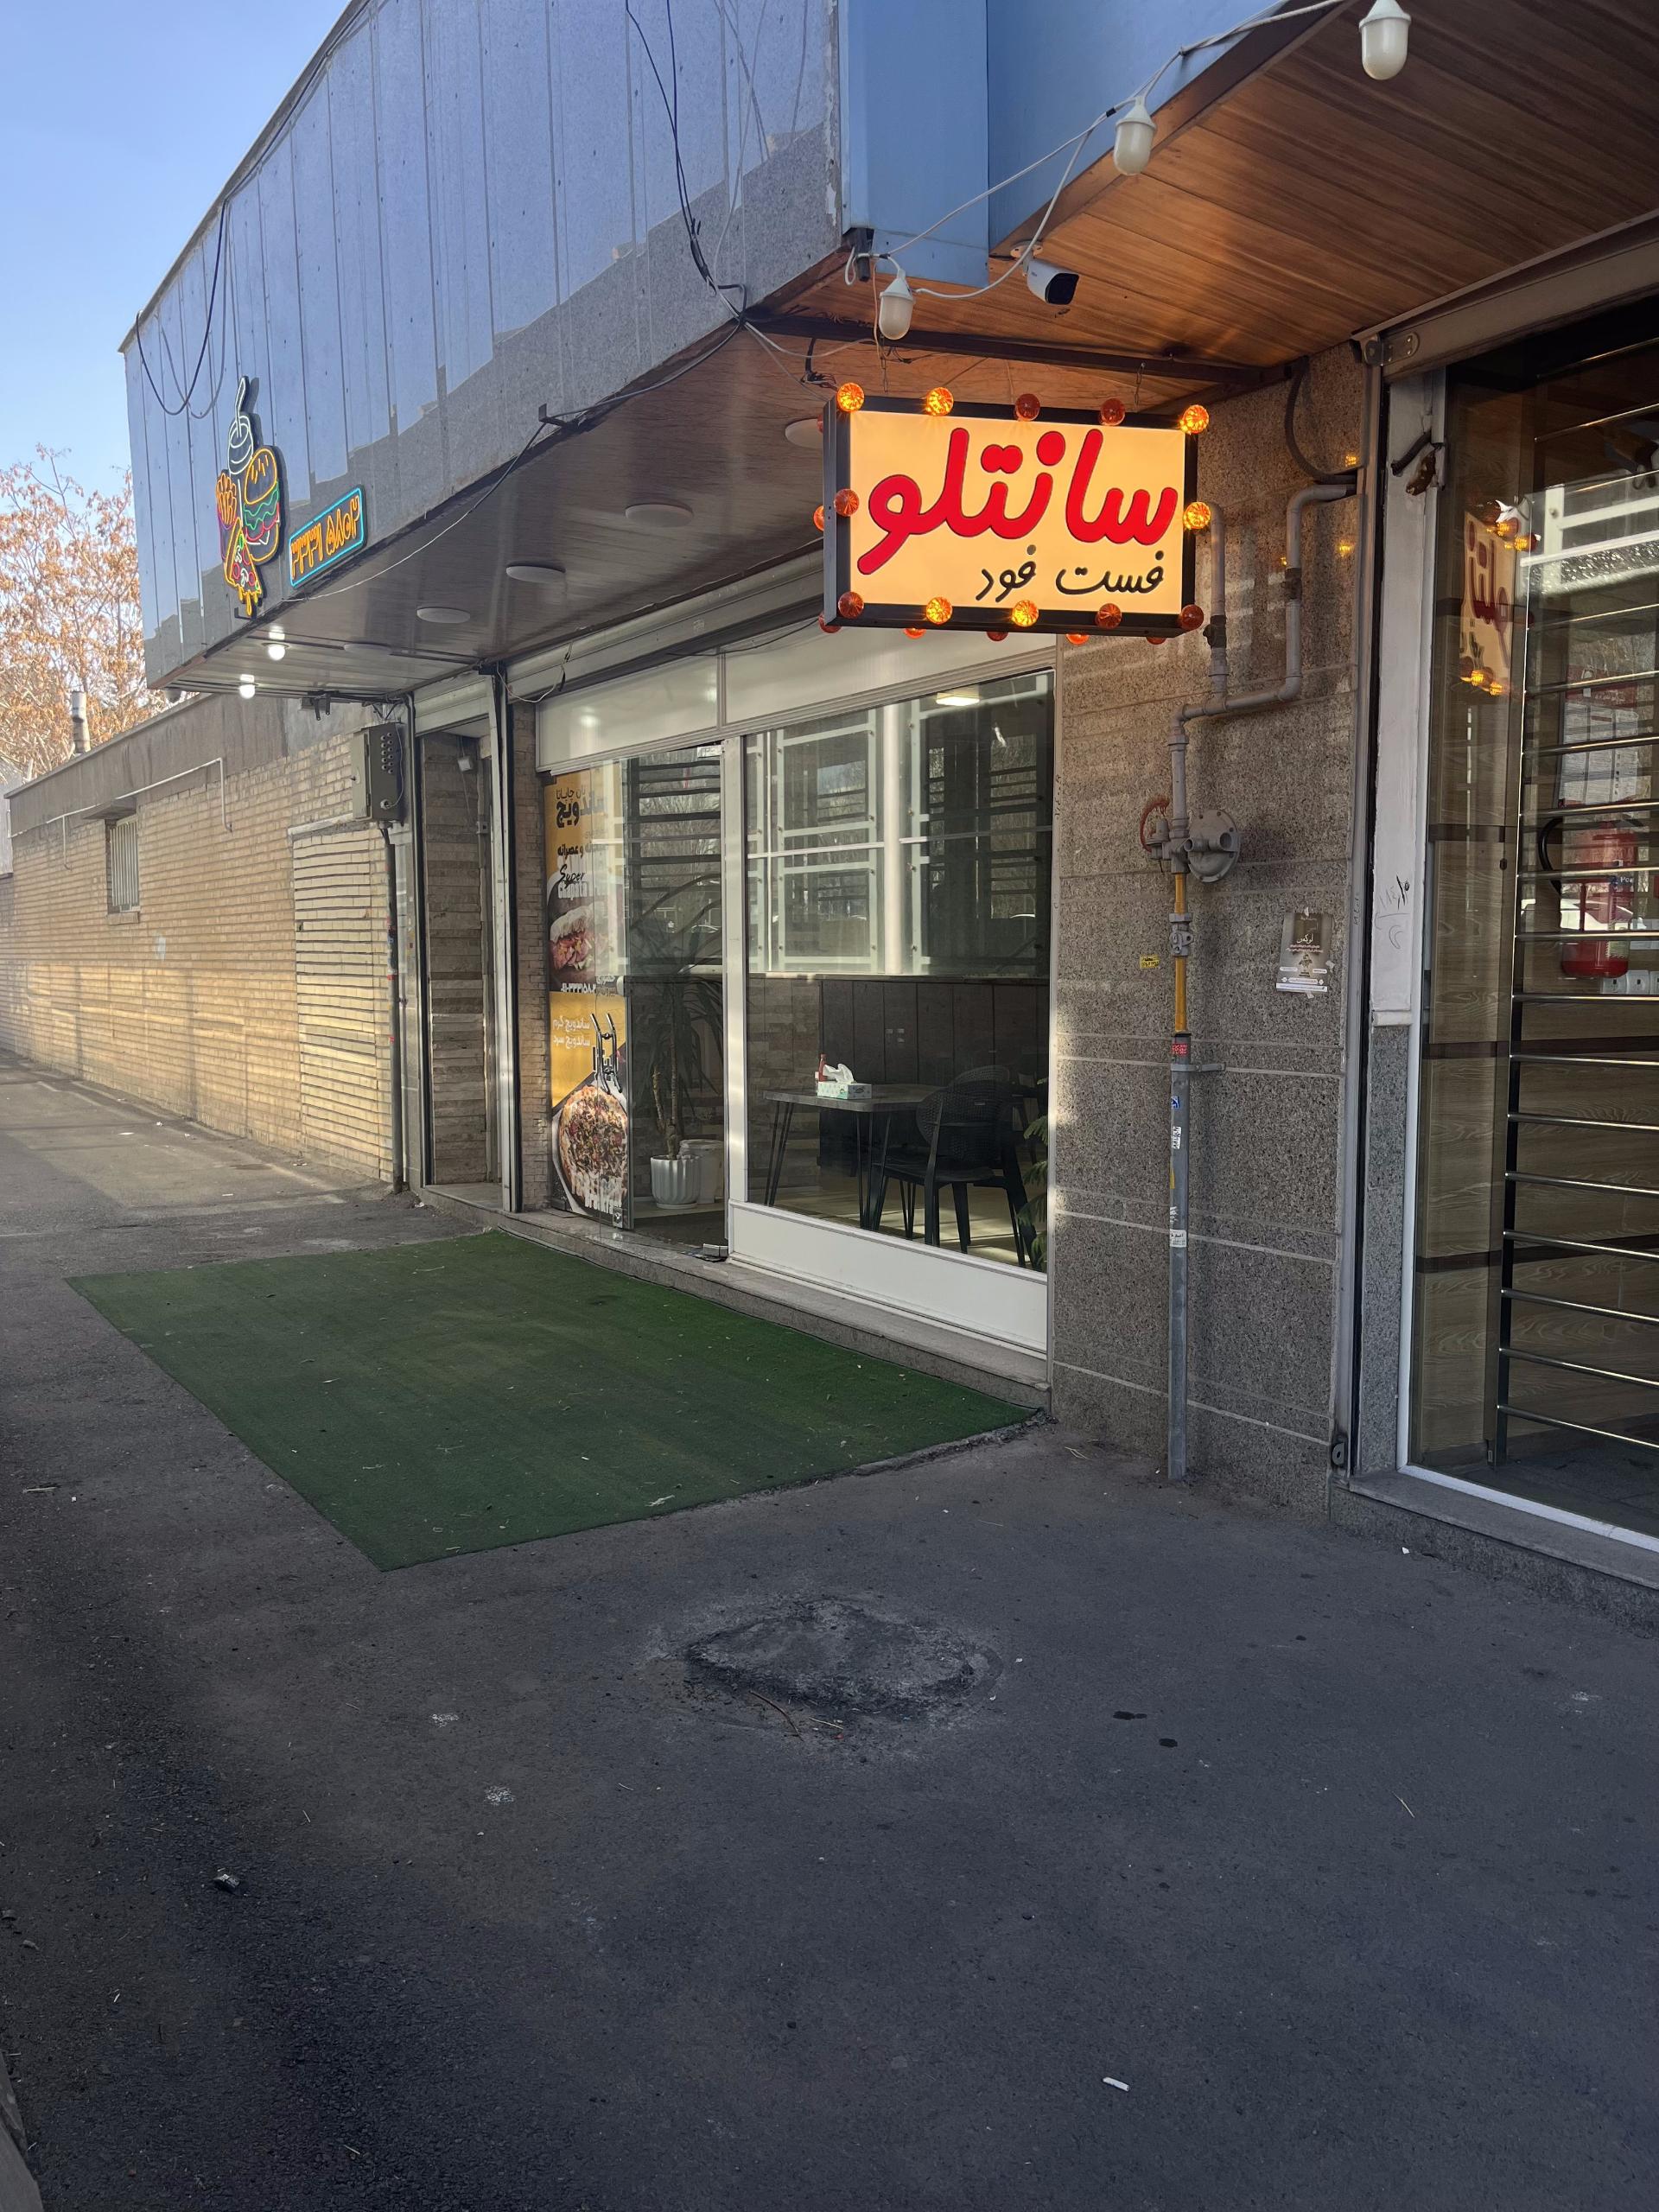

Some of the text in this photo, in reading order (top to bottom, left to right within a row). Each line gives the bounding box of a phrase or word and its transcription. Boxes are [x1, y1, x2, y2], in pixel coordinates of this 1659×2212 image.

[856, 428, 1178, 575] سانتلو
[975, 544, 1164, 602] فست فود
[557, 844, 579, 860] عصرانه
[566, 1018, 590, 1033] ساندویچ
[566, 1034, 590, 1049] ساندویچ
